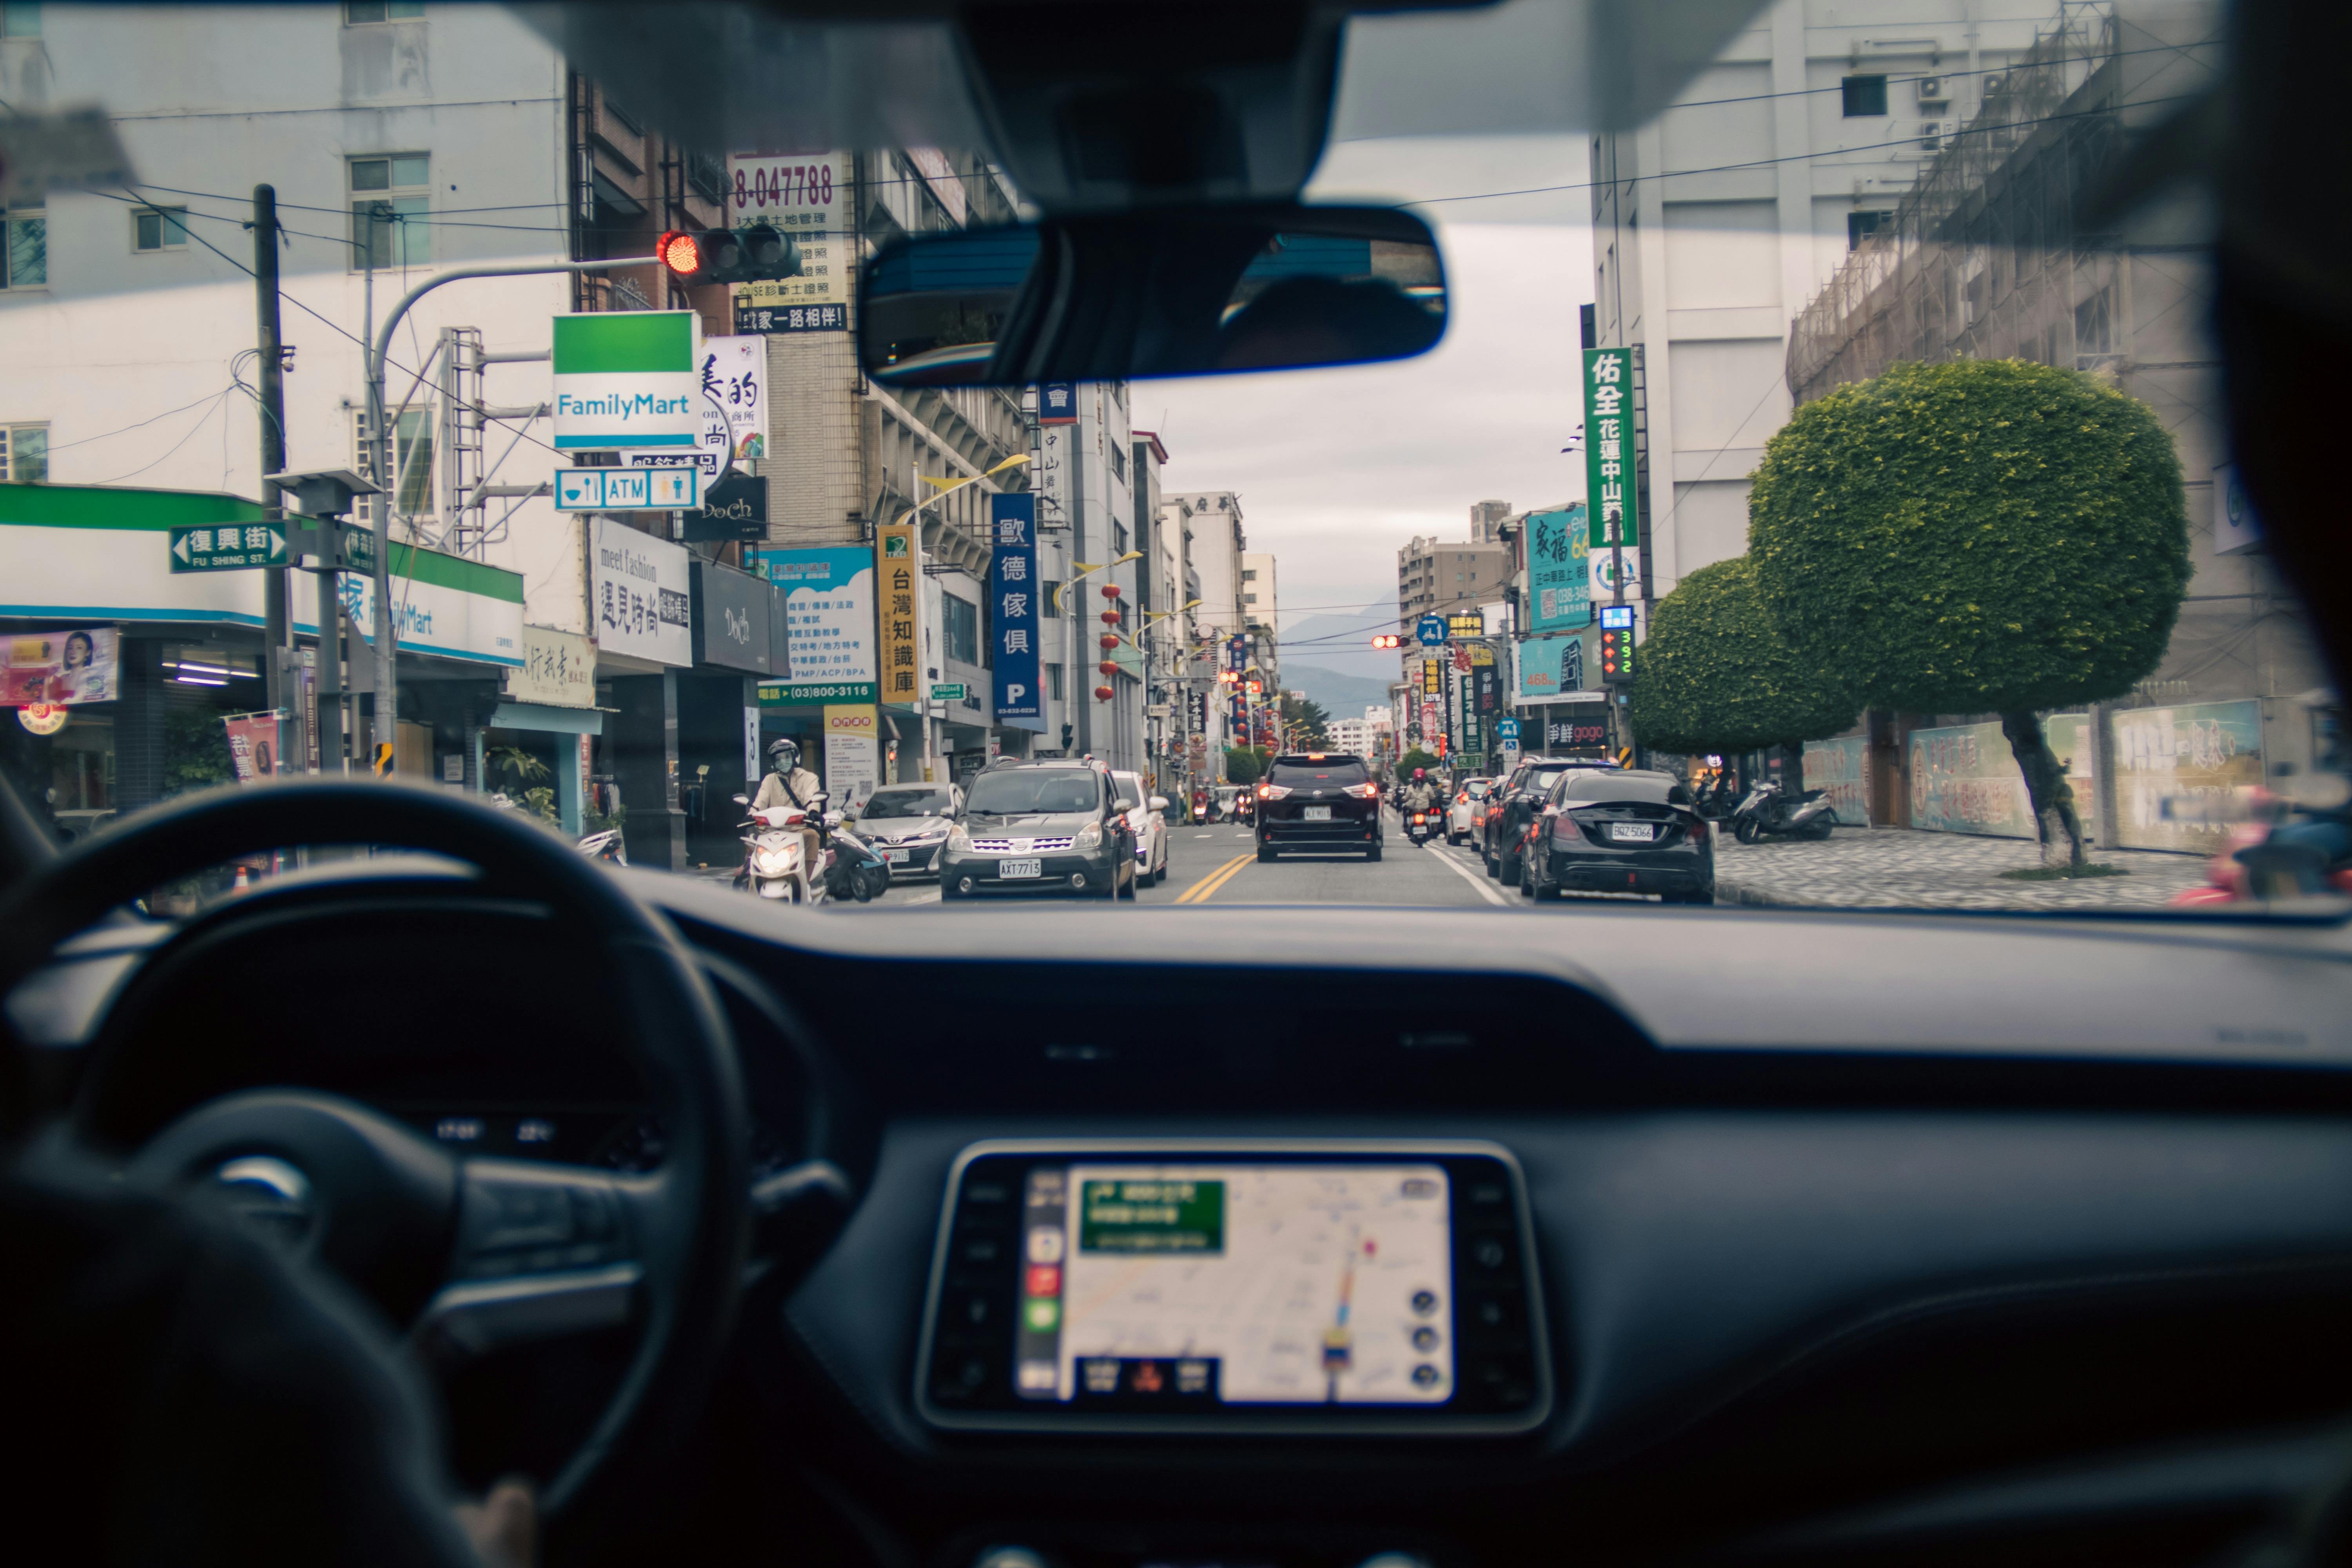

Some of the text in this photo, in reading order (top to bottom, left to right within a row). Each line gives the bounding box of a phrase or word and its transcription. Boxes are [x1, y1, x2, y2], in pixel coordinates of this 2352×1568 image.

[558, 393, 689, 421] FamilyMart
[609, 479, 644, 499] ATM
[189, 526, 268, 552] 復興街
[192, 554, 266, 567] FU SHING ST.
[601, 548, 657, 583] meet fashion
[999, 518, 1029, 654] 歐德傢俱
[370, 596, 432, 638] FilyMart
[601, 581, 658, 638] 遇見時尚
[892, 568, 915, 693] 台灣知識庫
[795, 668, 866, 678] PMP/ACP/BPA
[758, 686, 869, 700] 電話 (03)800-3116
[1007, 684, 1025, 704] P
